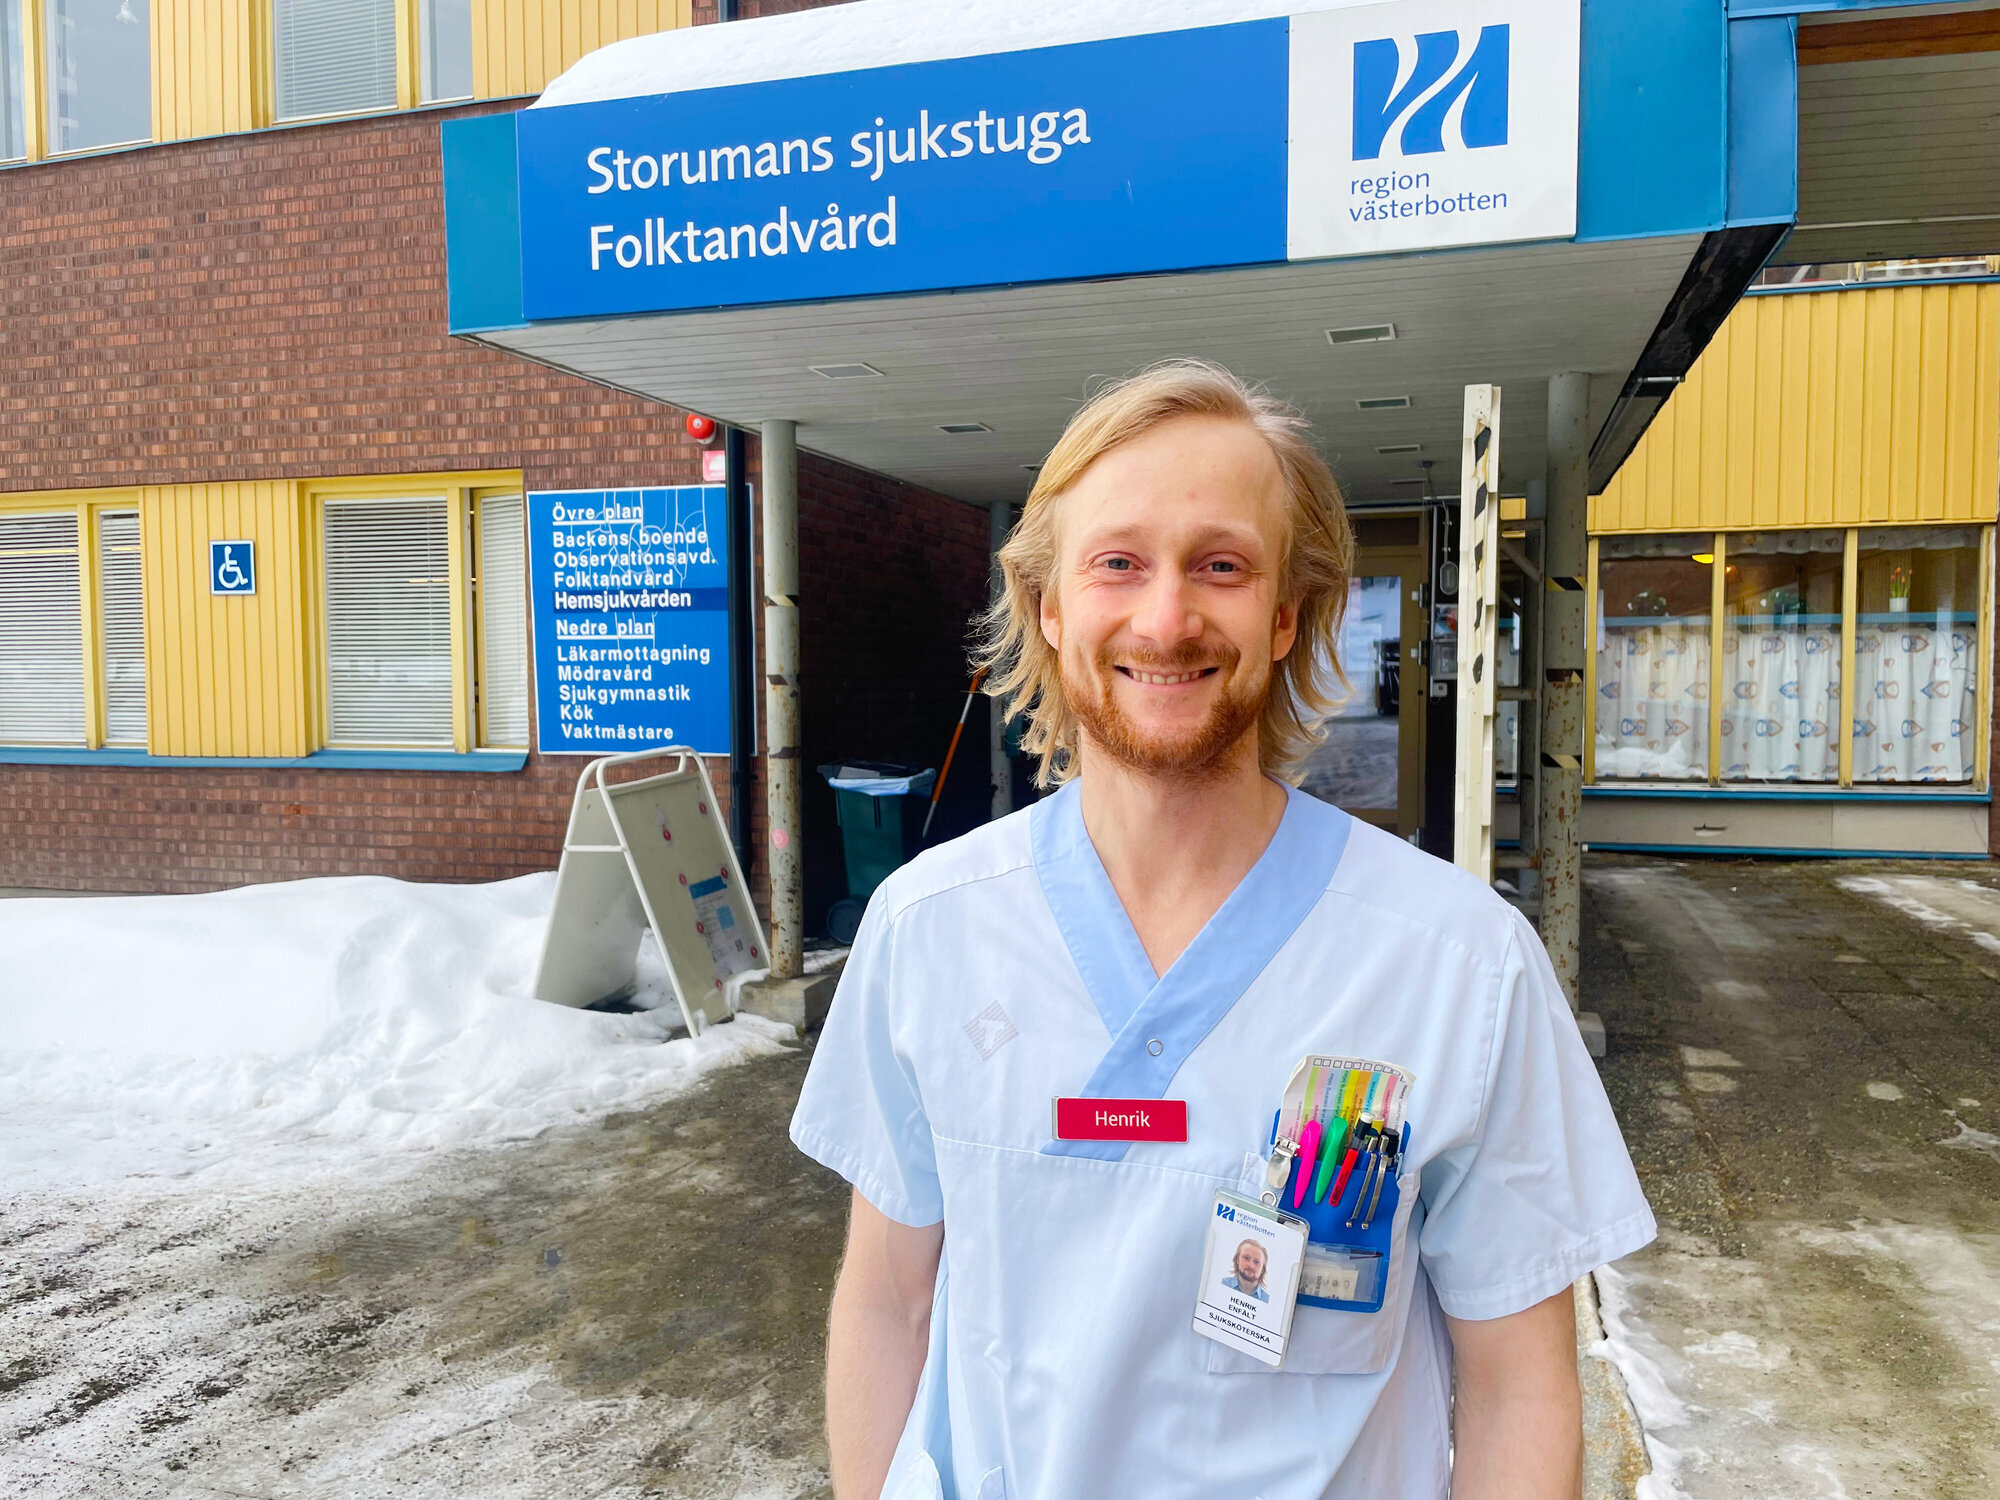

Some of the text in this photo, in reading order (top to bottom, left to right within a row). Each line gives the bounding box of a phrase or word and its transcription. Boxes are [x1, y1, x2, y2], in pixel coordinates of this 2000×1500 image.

[588, 107, 1092, 194] Storumans sjukstuga
[1351, 171, 1430, 199] region
[1349, 192, 1507, 222] västerbotten
[588, 192, 898, 271] Folktandvård
[552, 502, 643, 522] Övre plan
[553, 528, 708, 548] Backens boende
[554, 549, 717, 567] Observationsavd.
[554, 590, 692, 613] Hemsjukvården
[556, 619, 655, 637] Nedre plan
[557, 644, 711, 665] Läkarmottagning
[558, 664, 652, 682] Mödravård
[559, 684, 691, 705] Sjukgymnastik
[560, 704, 594, 720] Kök
[561, 722, 674, 740] Vaktmästare
[1095, 1110, 1151, 1128] Henrik
[1237, 1211, 1258, 1224] region
[1236, 1218, 1276, 1238] västerbotten
[1230, 1296, 1257, 1312] HENRIK
[1209, 1312, 1271, 1344] SJUKSKÖTERSKA
